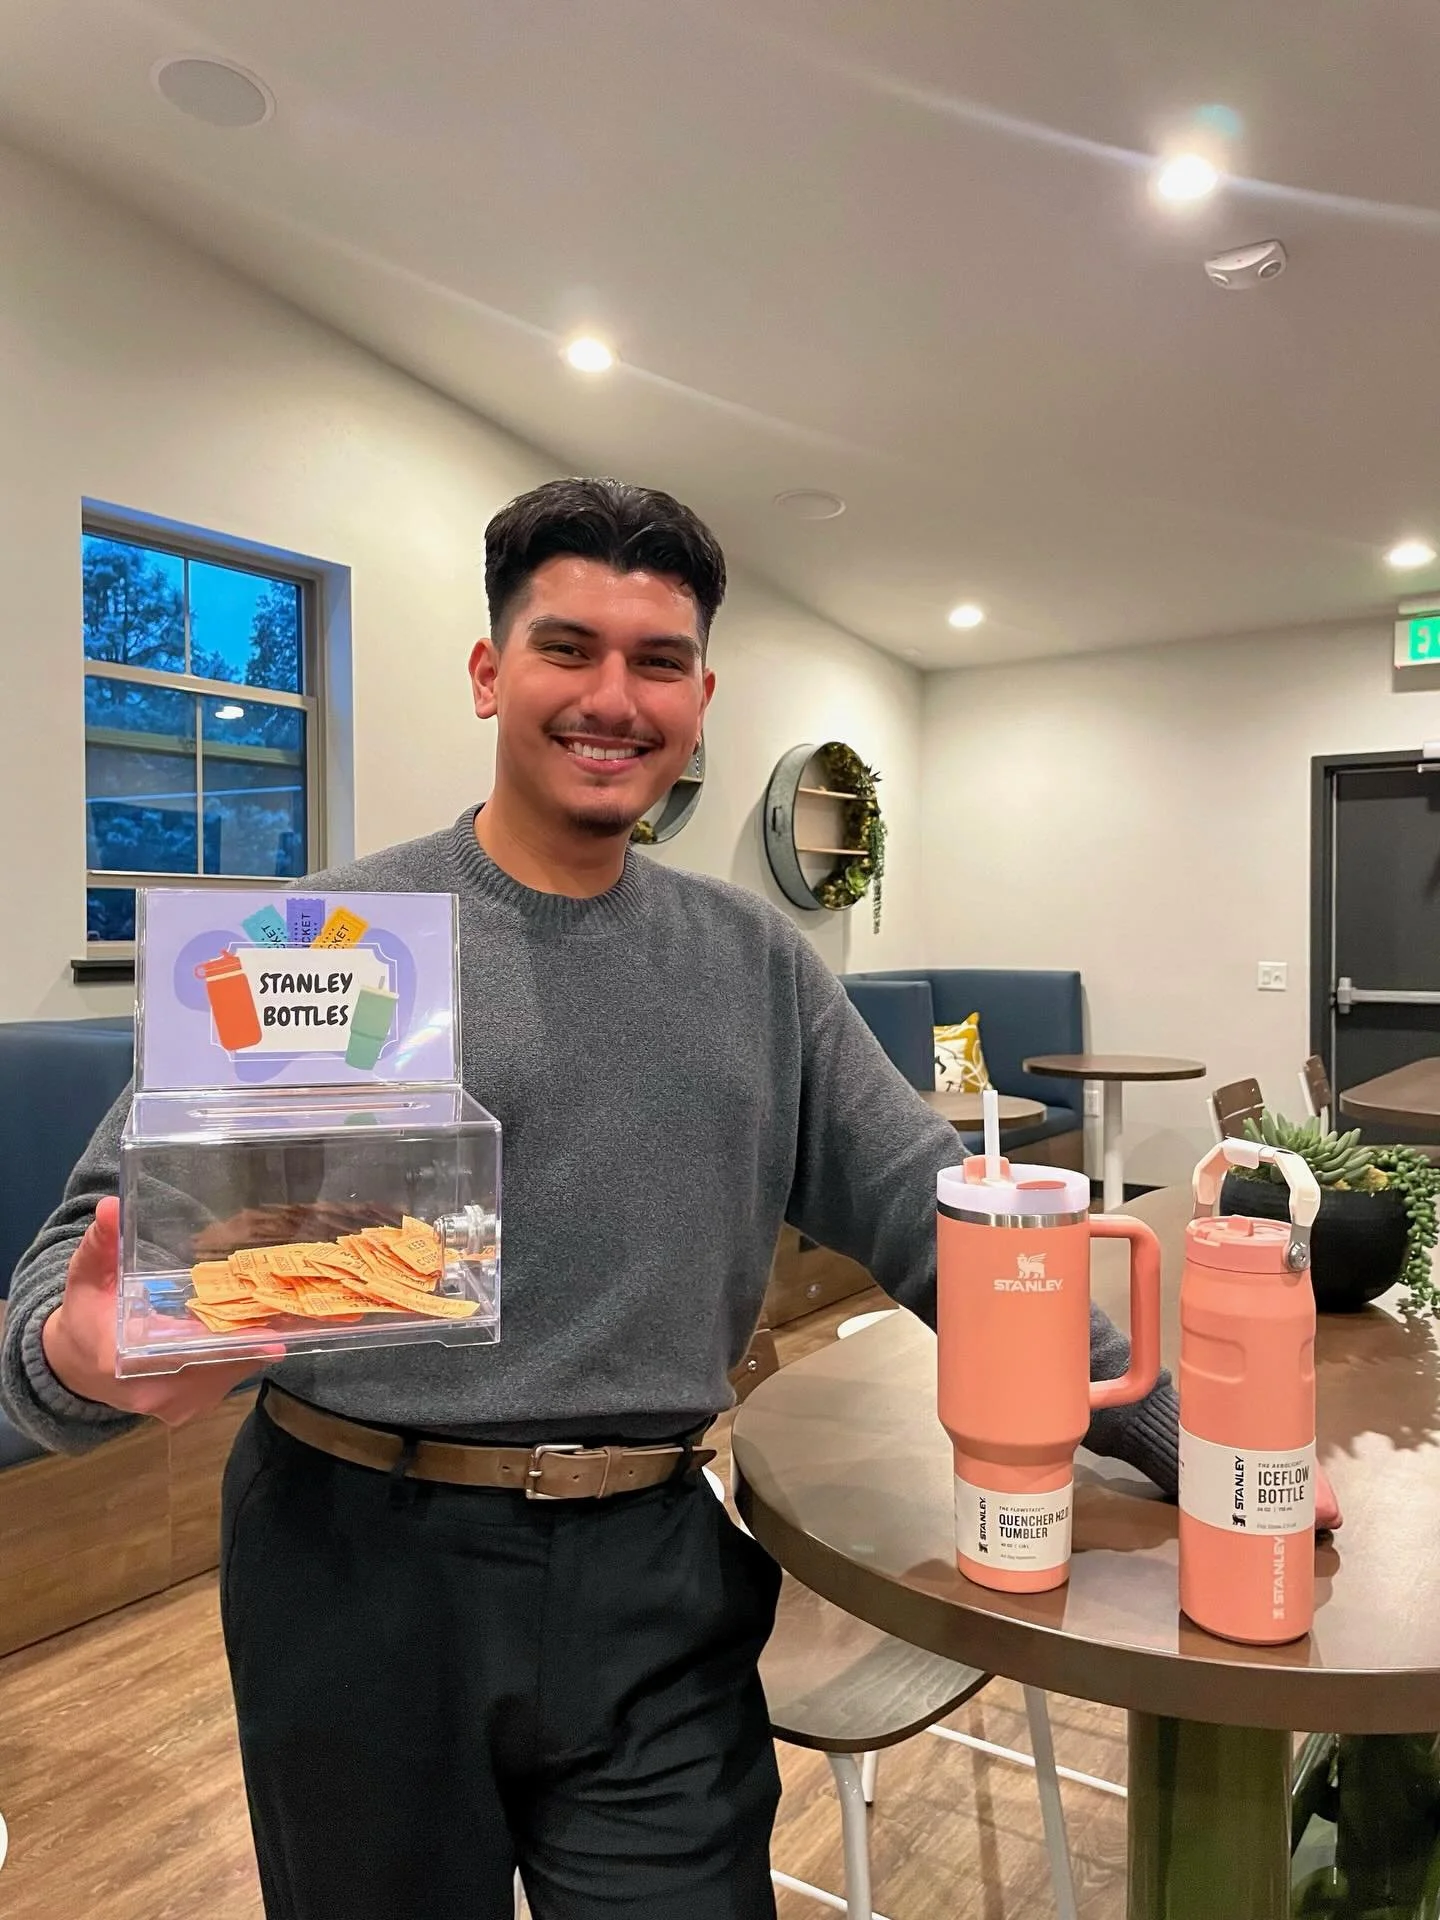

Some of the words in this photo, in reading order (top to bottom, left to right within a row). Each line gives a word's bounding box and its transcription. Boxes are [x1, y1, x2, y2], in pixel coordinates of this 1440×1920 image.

[259, 972, 353, 995] STANLEY
[263, 1004, 349, 1027] BOTTLES
[993, 1279, 1064, 1292] STANLEY
[1234, 1455, 1245, 1511] STANLEY
[1258, 1465, 1310, 1487] ICEFLOW
[1258, 1485, 1305, 1504] BOTTLE
[999, 1513, 1054, 1527] QUENCHER
[999, 1526, 1048, 1539] TUMBLER
[1273, 1536, 1286, 1605] STANLEY
